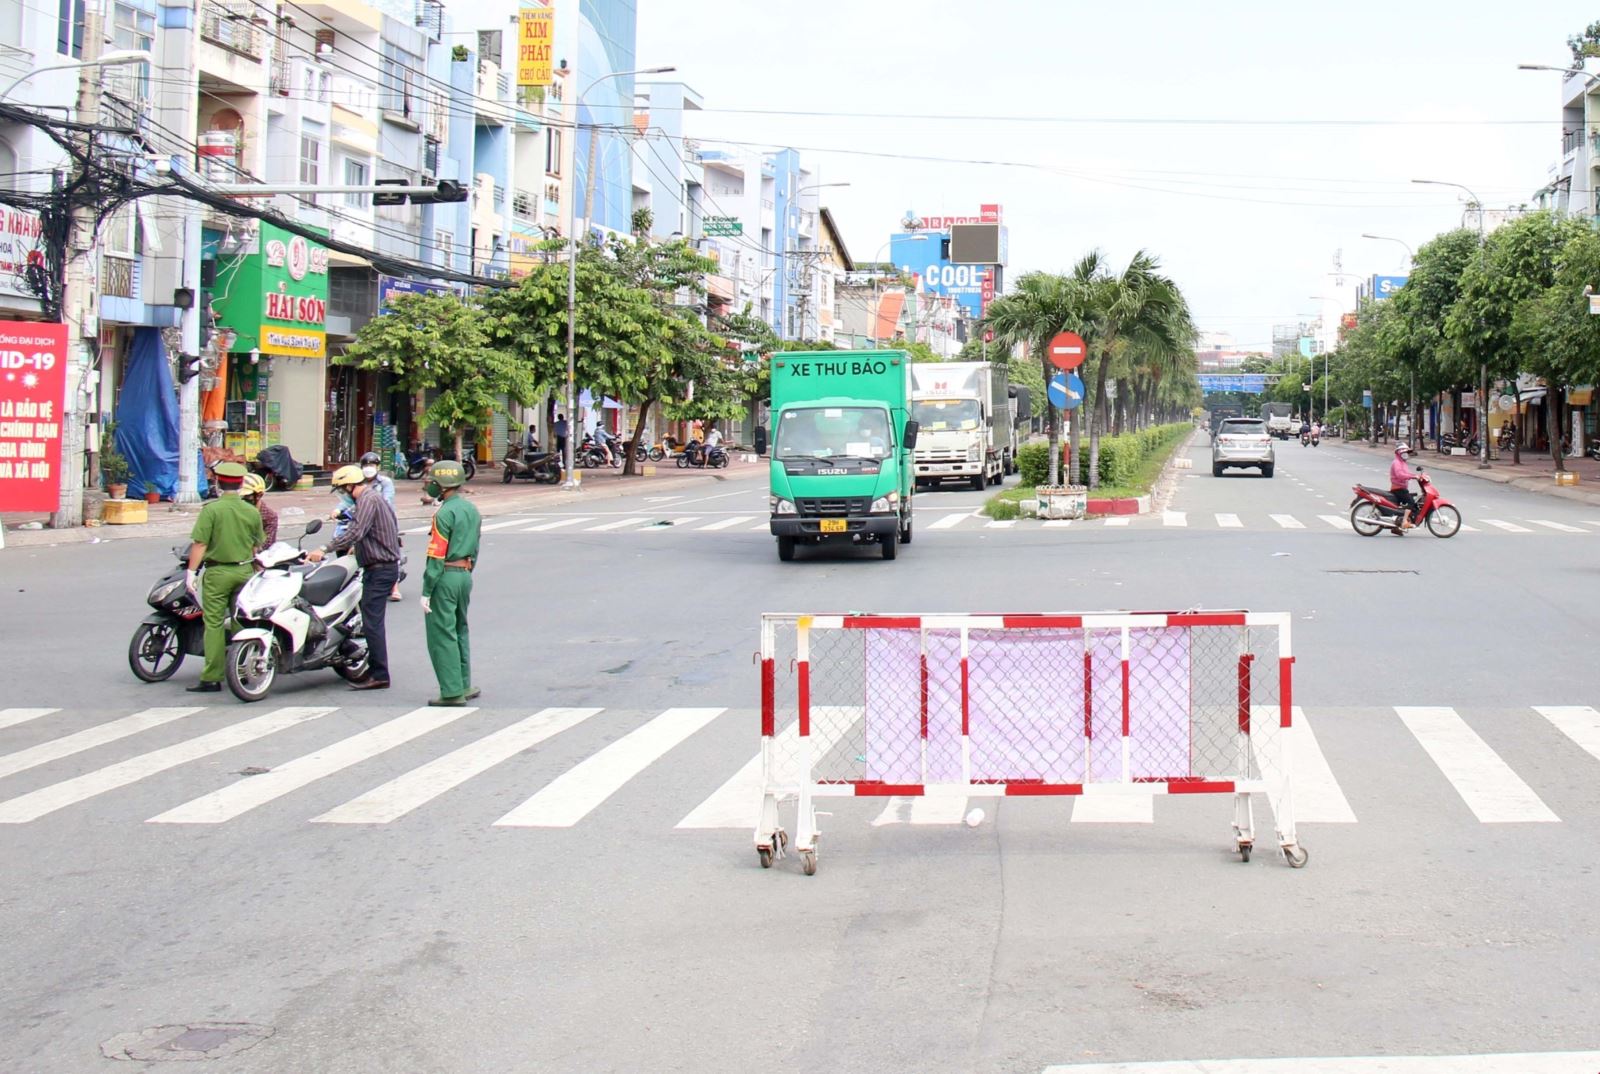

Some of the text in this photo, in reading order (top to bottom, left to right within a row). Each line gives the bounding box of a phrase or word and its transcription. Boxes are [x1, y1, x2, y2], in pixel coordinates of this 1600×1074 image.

[526, 22, 547, 38] KIM
[520, 40, 551, 61] PHÁT
[926, 264, 982, 287] COOL
[266, 282, 326, 324] HẢI SƠN
[0, 350, 55, 370] ID-19
[791, 359, 887, 376] XE THƯ BÁO
[1, 398, 53, 421] LÀ BẢO VỆ
[0, 419, 58, 442] CHÍNH BẠN
[20, 440, 46, 458] ĐÌNH
[15, 460, 29, 478] XÃ
[31, 461, 50, 482] HỘI
